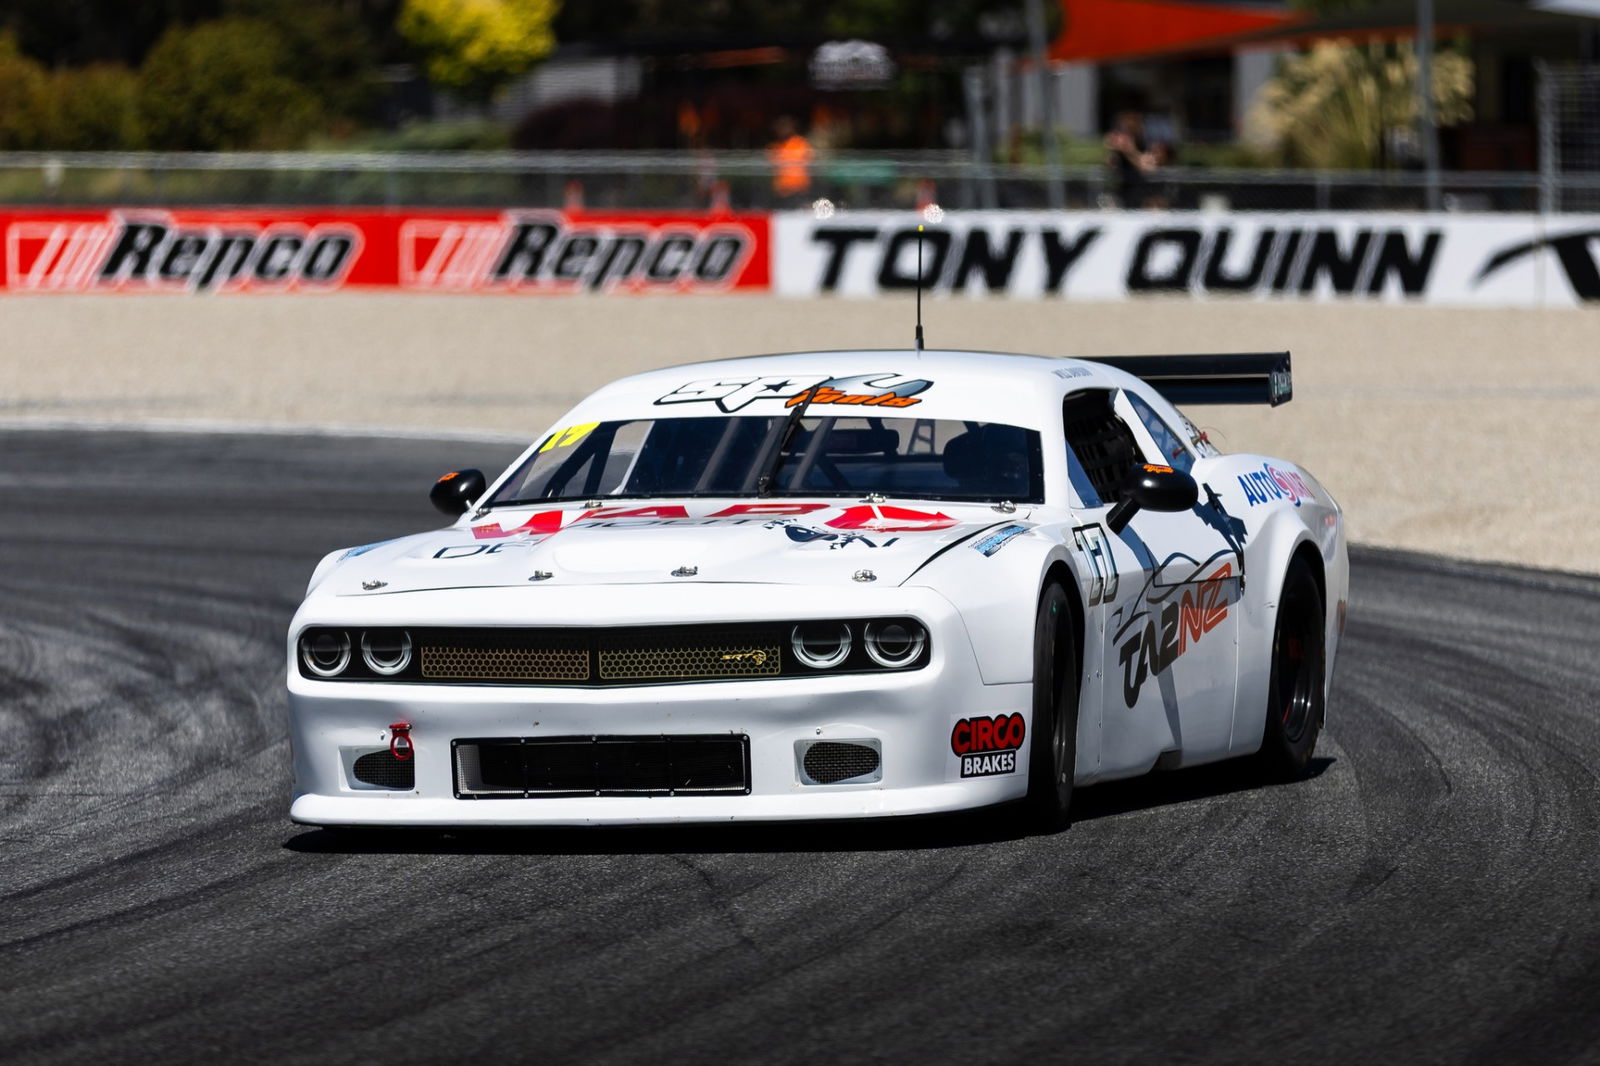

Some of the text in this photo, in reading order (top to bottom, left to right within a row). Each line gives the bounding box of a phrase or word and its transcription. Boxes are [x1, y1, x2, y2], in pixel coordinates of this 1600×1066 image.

[101, 218, 358, 291] Repco
[494, 217, 749, 291] Repco
[811, 227, 1443, 296] TONY QUINN
[951, 712, 1025, 757] CIRCO
[963, 752, 1015, 776] BRAKES
